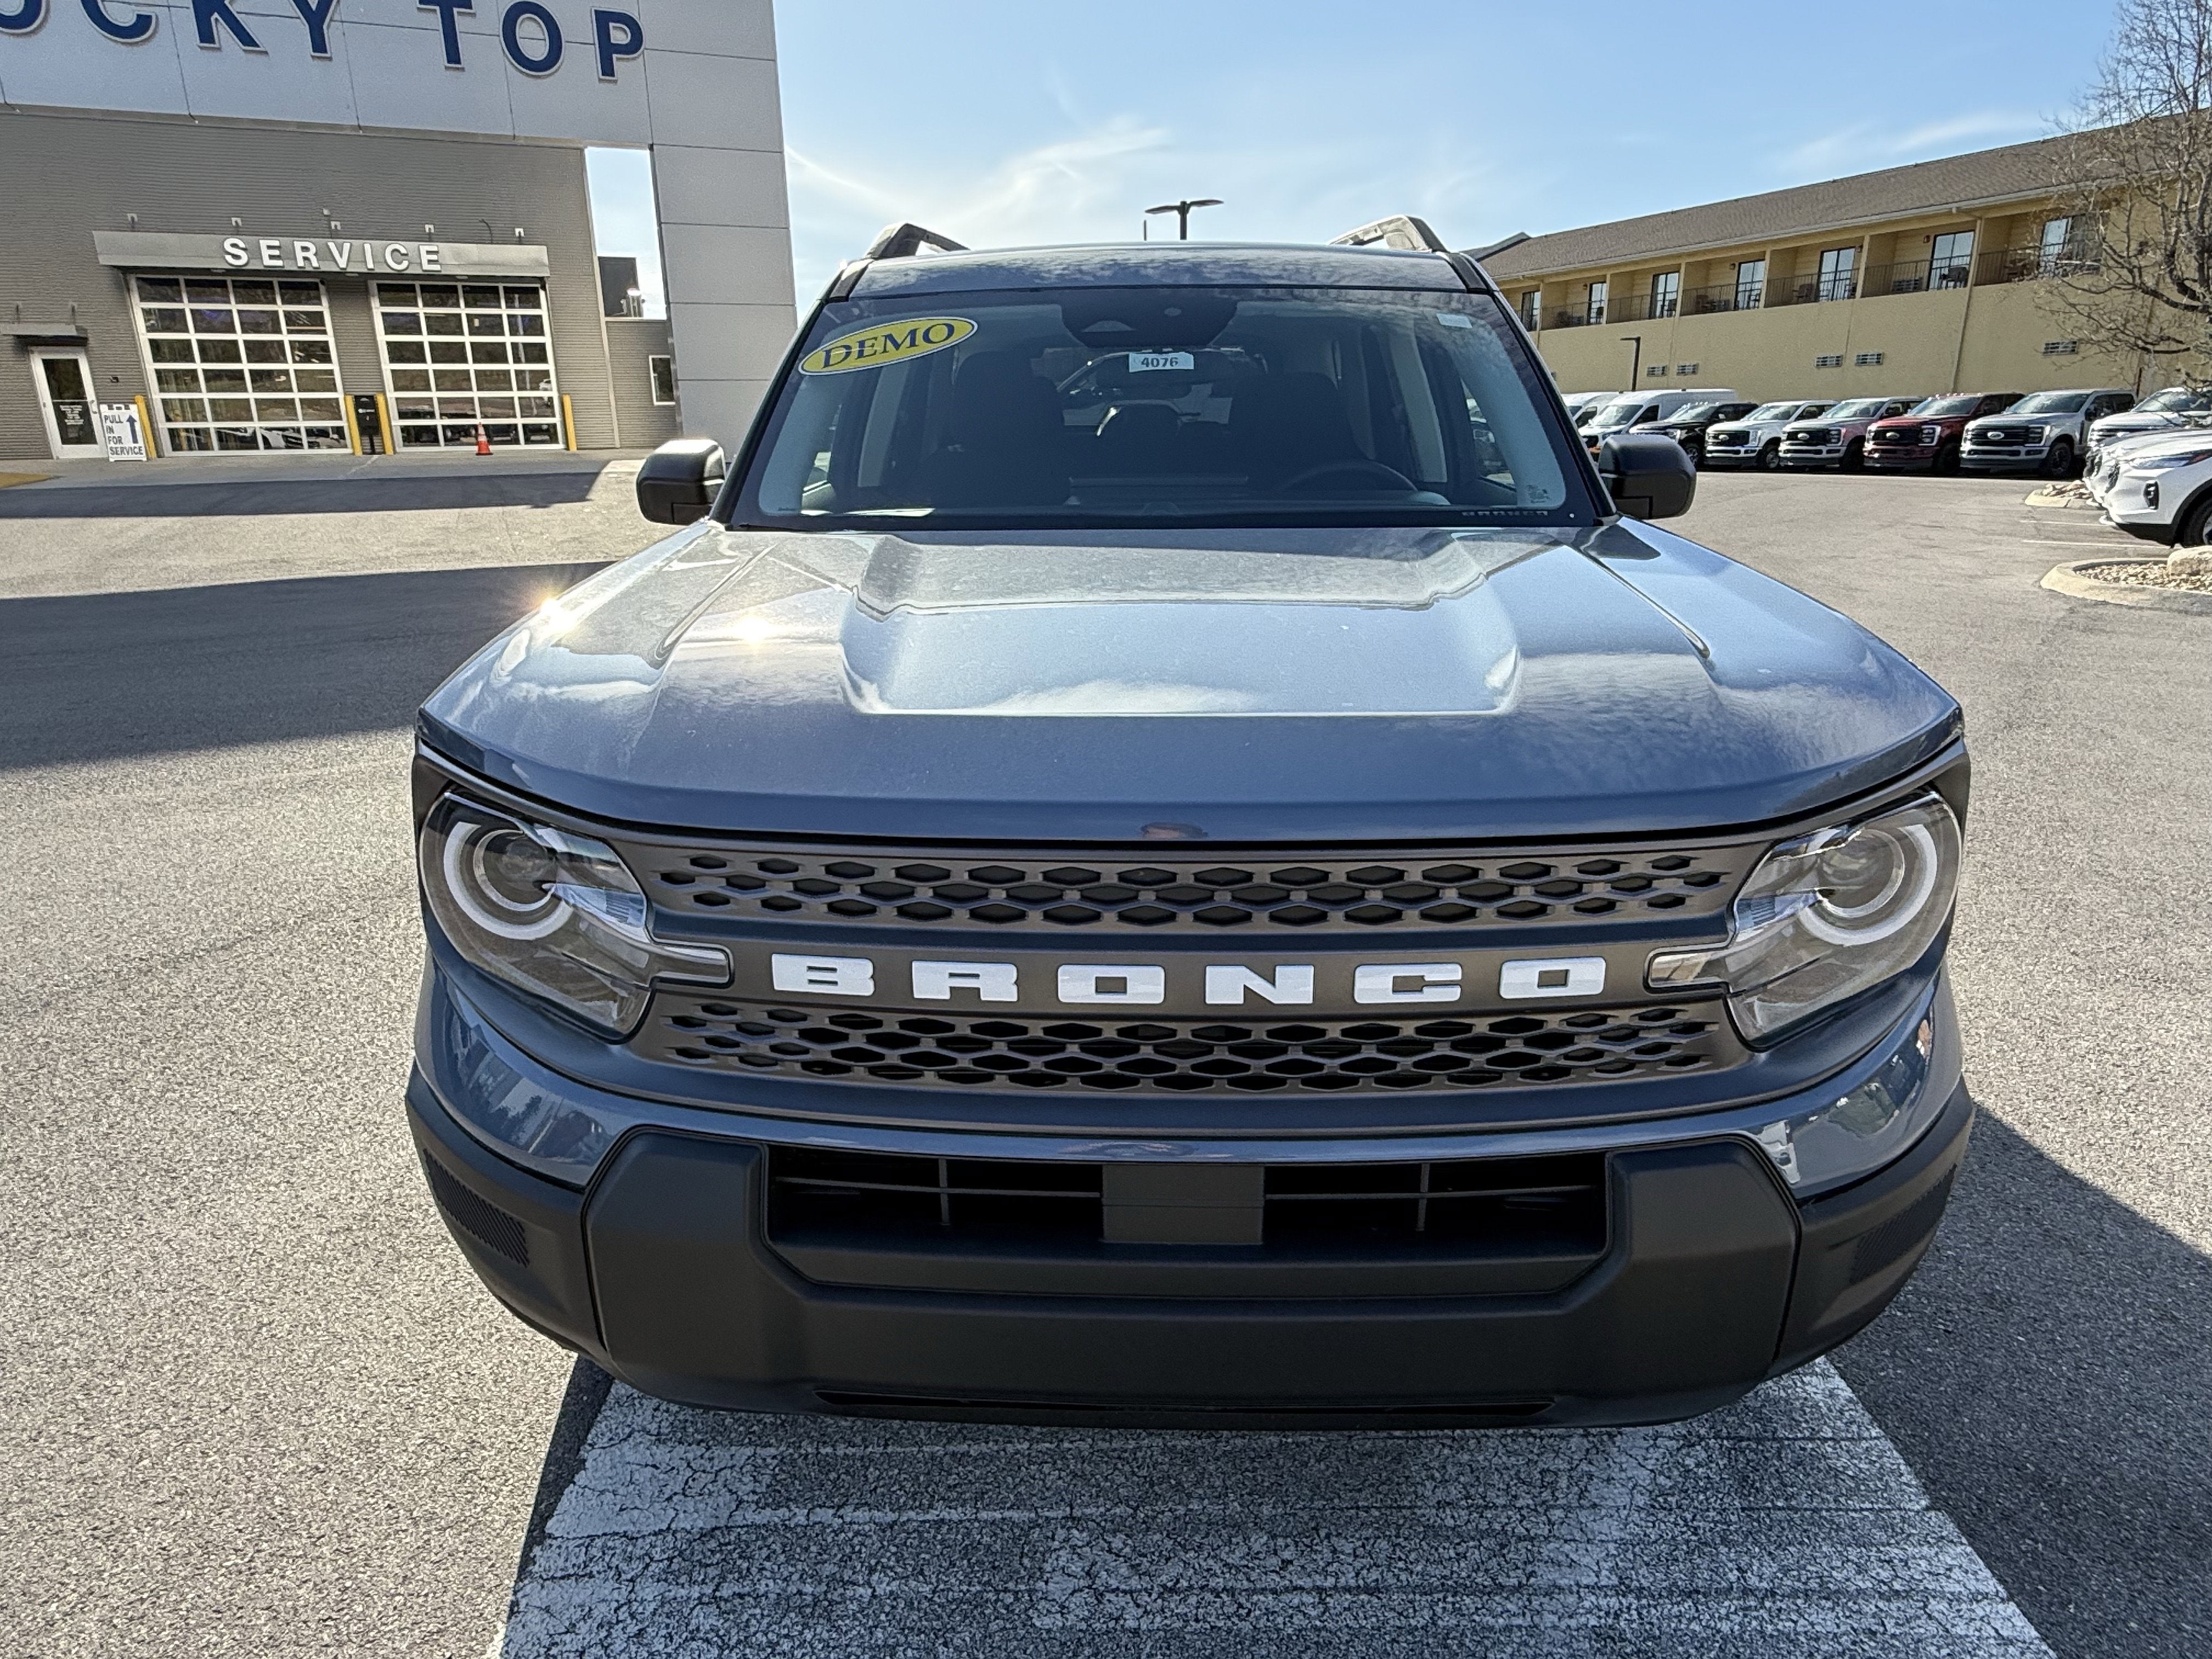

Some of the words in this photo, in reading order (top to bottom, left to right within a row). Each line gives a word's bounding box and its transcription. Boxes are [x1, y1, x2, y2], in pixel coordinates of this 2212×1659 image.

[417, 0, 645, 80] TOP
[223, 238, 442, 272] SERVICE
[821, 323, 955, 369] DEMO
[1141, 357, 1178, 368] 4076
[104, 414, 123, 424] PULL
[106, 425, 115, 435] IN
[108, 436, 123, 445] FOR
[110, 446, 144, 455] SERVICE
[771, 953, 1606, 1005] BRONCO
